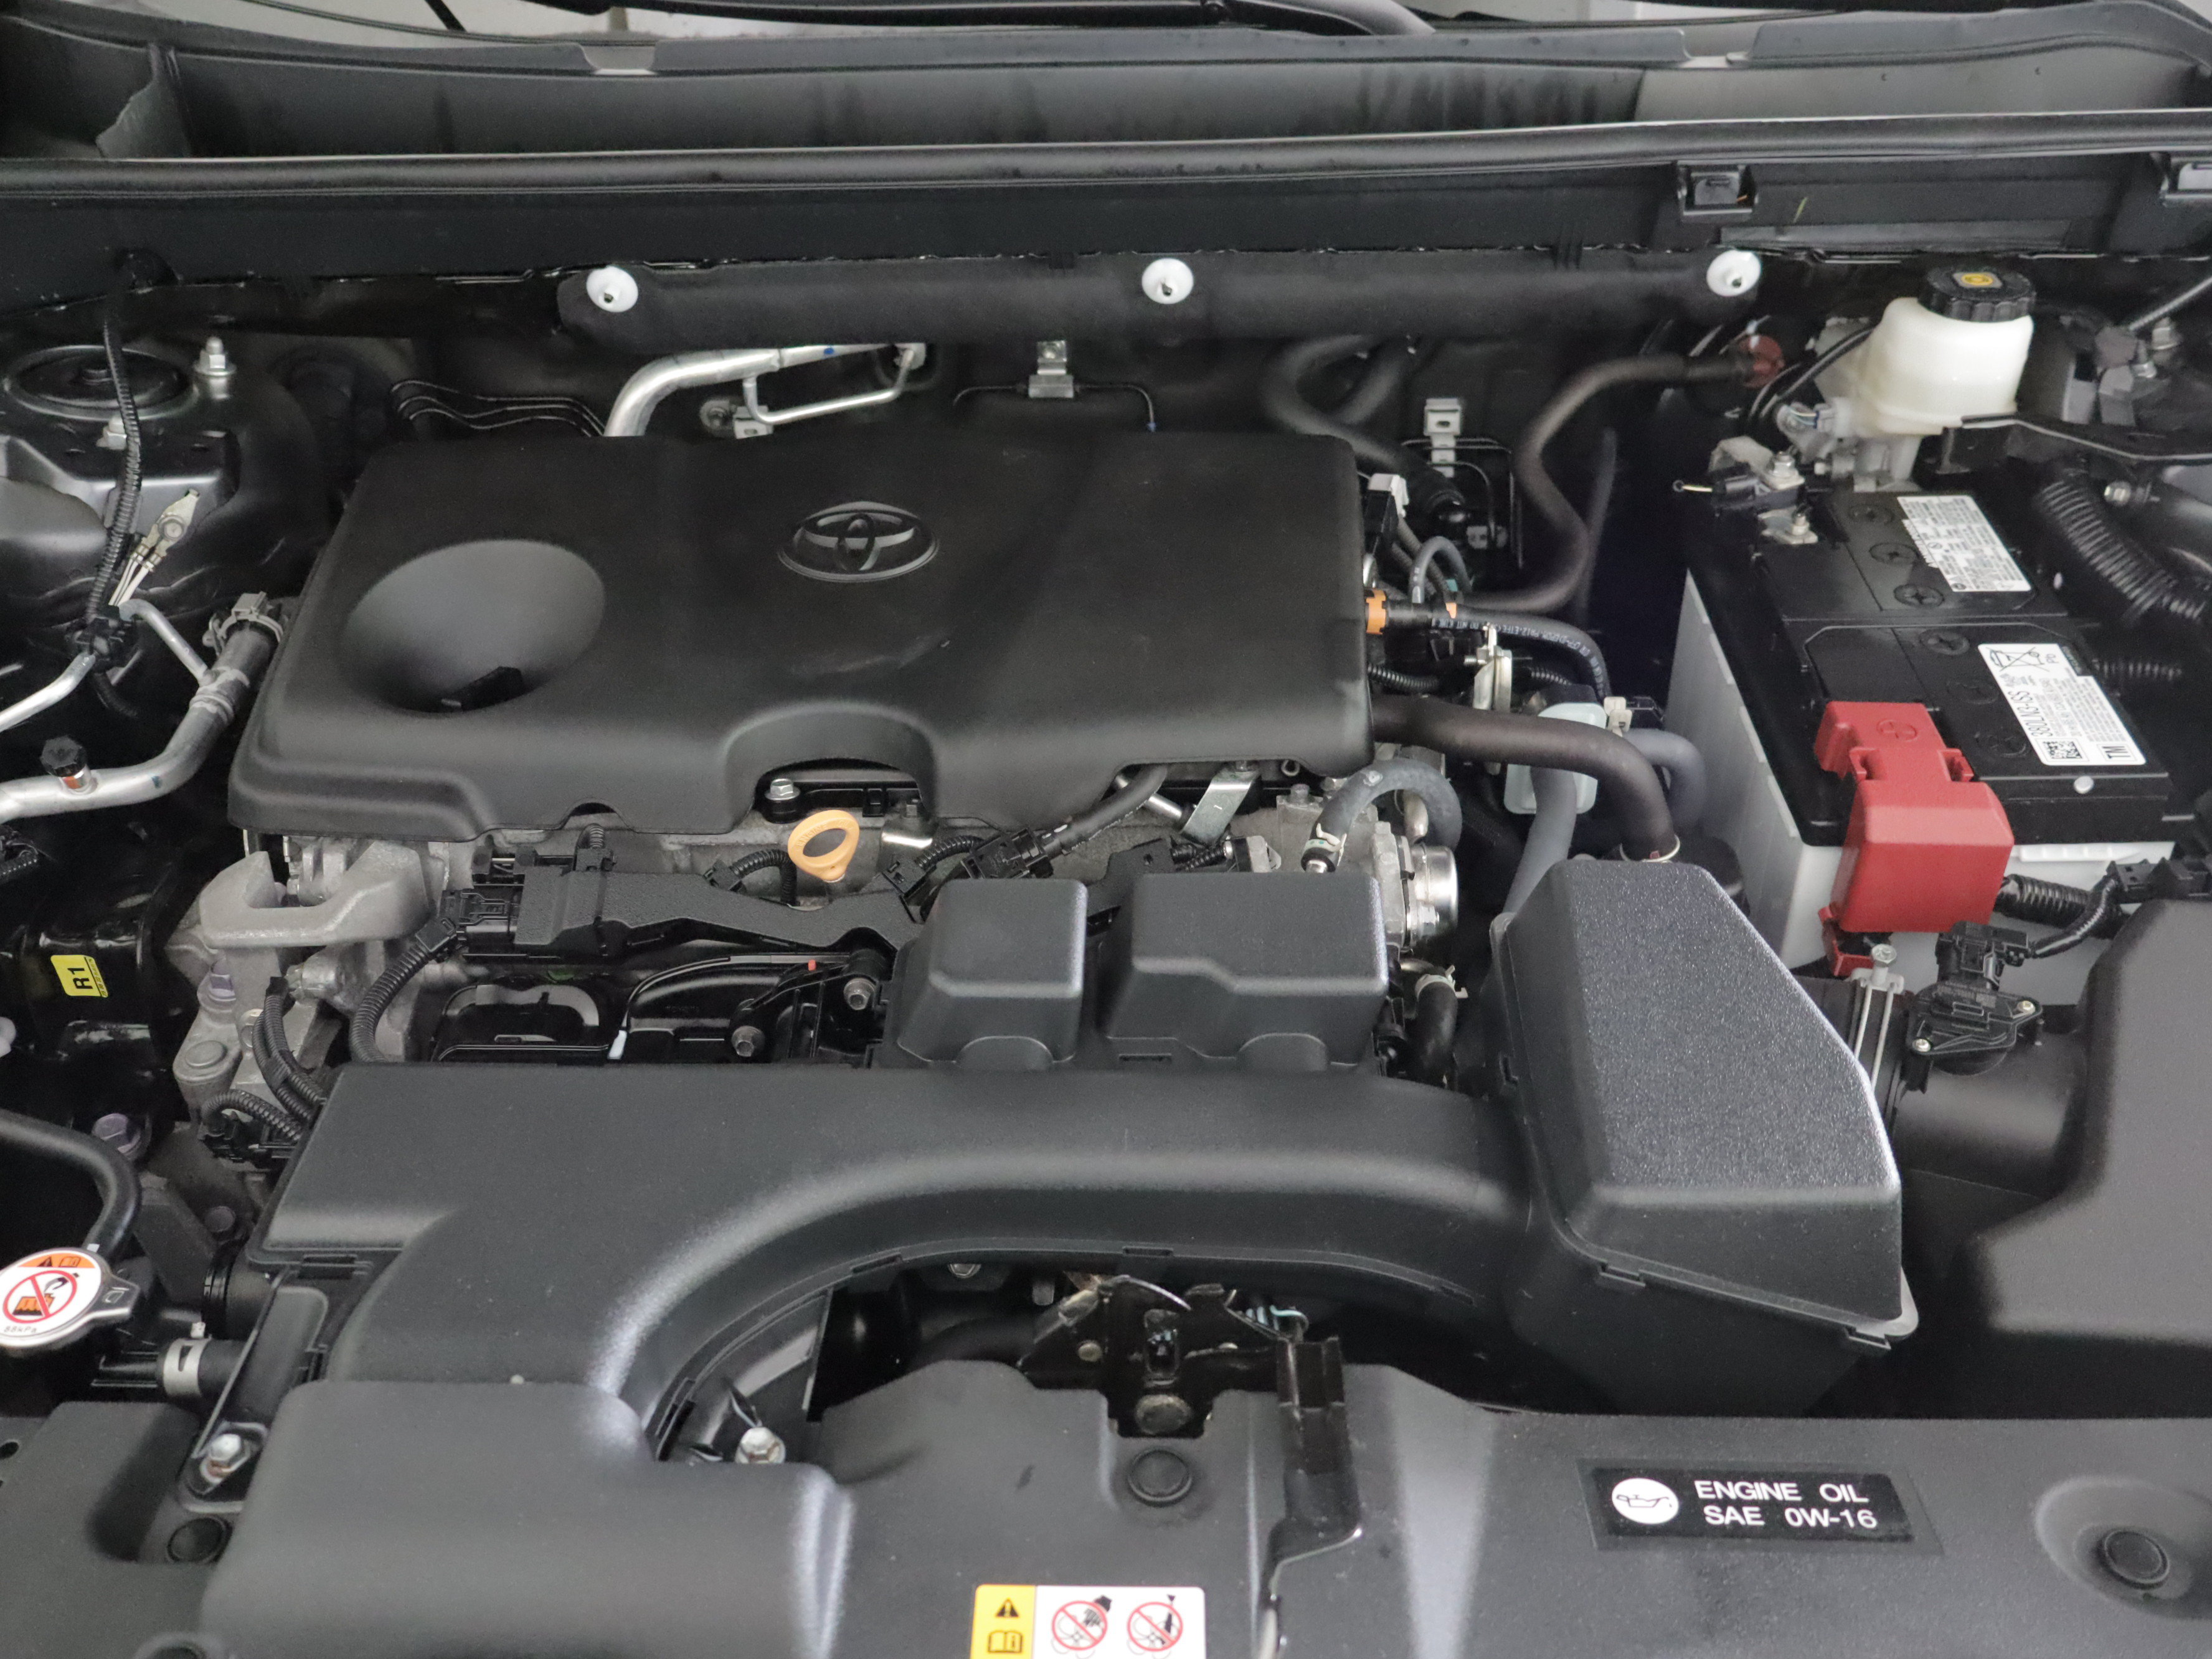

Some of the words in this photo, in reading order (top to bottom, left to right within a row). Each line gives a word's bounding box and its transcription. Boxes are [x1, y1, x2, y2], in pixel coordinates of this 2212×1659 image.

[2046, 653, 2058, 664] Pb
[2008, 690, 2053, 737] 380LN3-ISS
[2102, 745, 2131, 759] TM
[797, 823, 828, 847] ENGINE
[67, 967, 93, 990] R1
[1694, 1480, 1802, 1501] ENGINE
[1819, 1484, 1869, 1503] OIL
[1704, 1505, 1765, 1526] SAE
[1785, 1508, 1878, 1529] 0W-16
